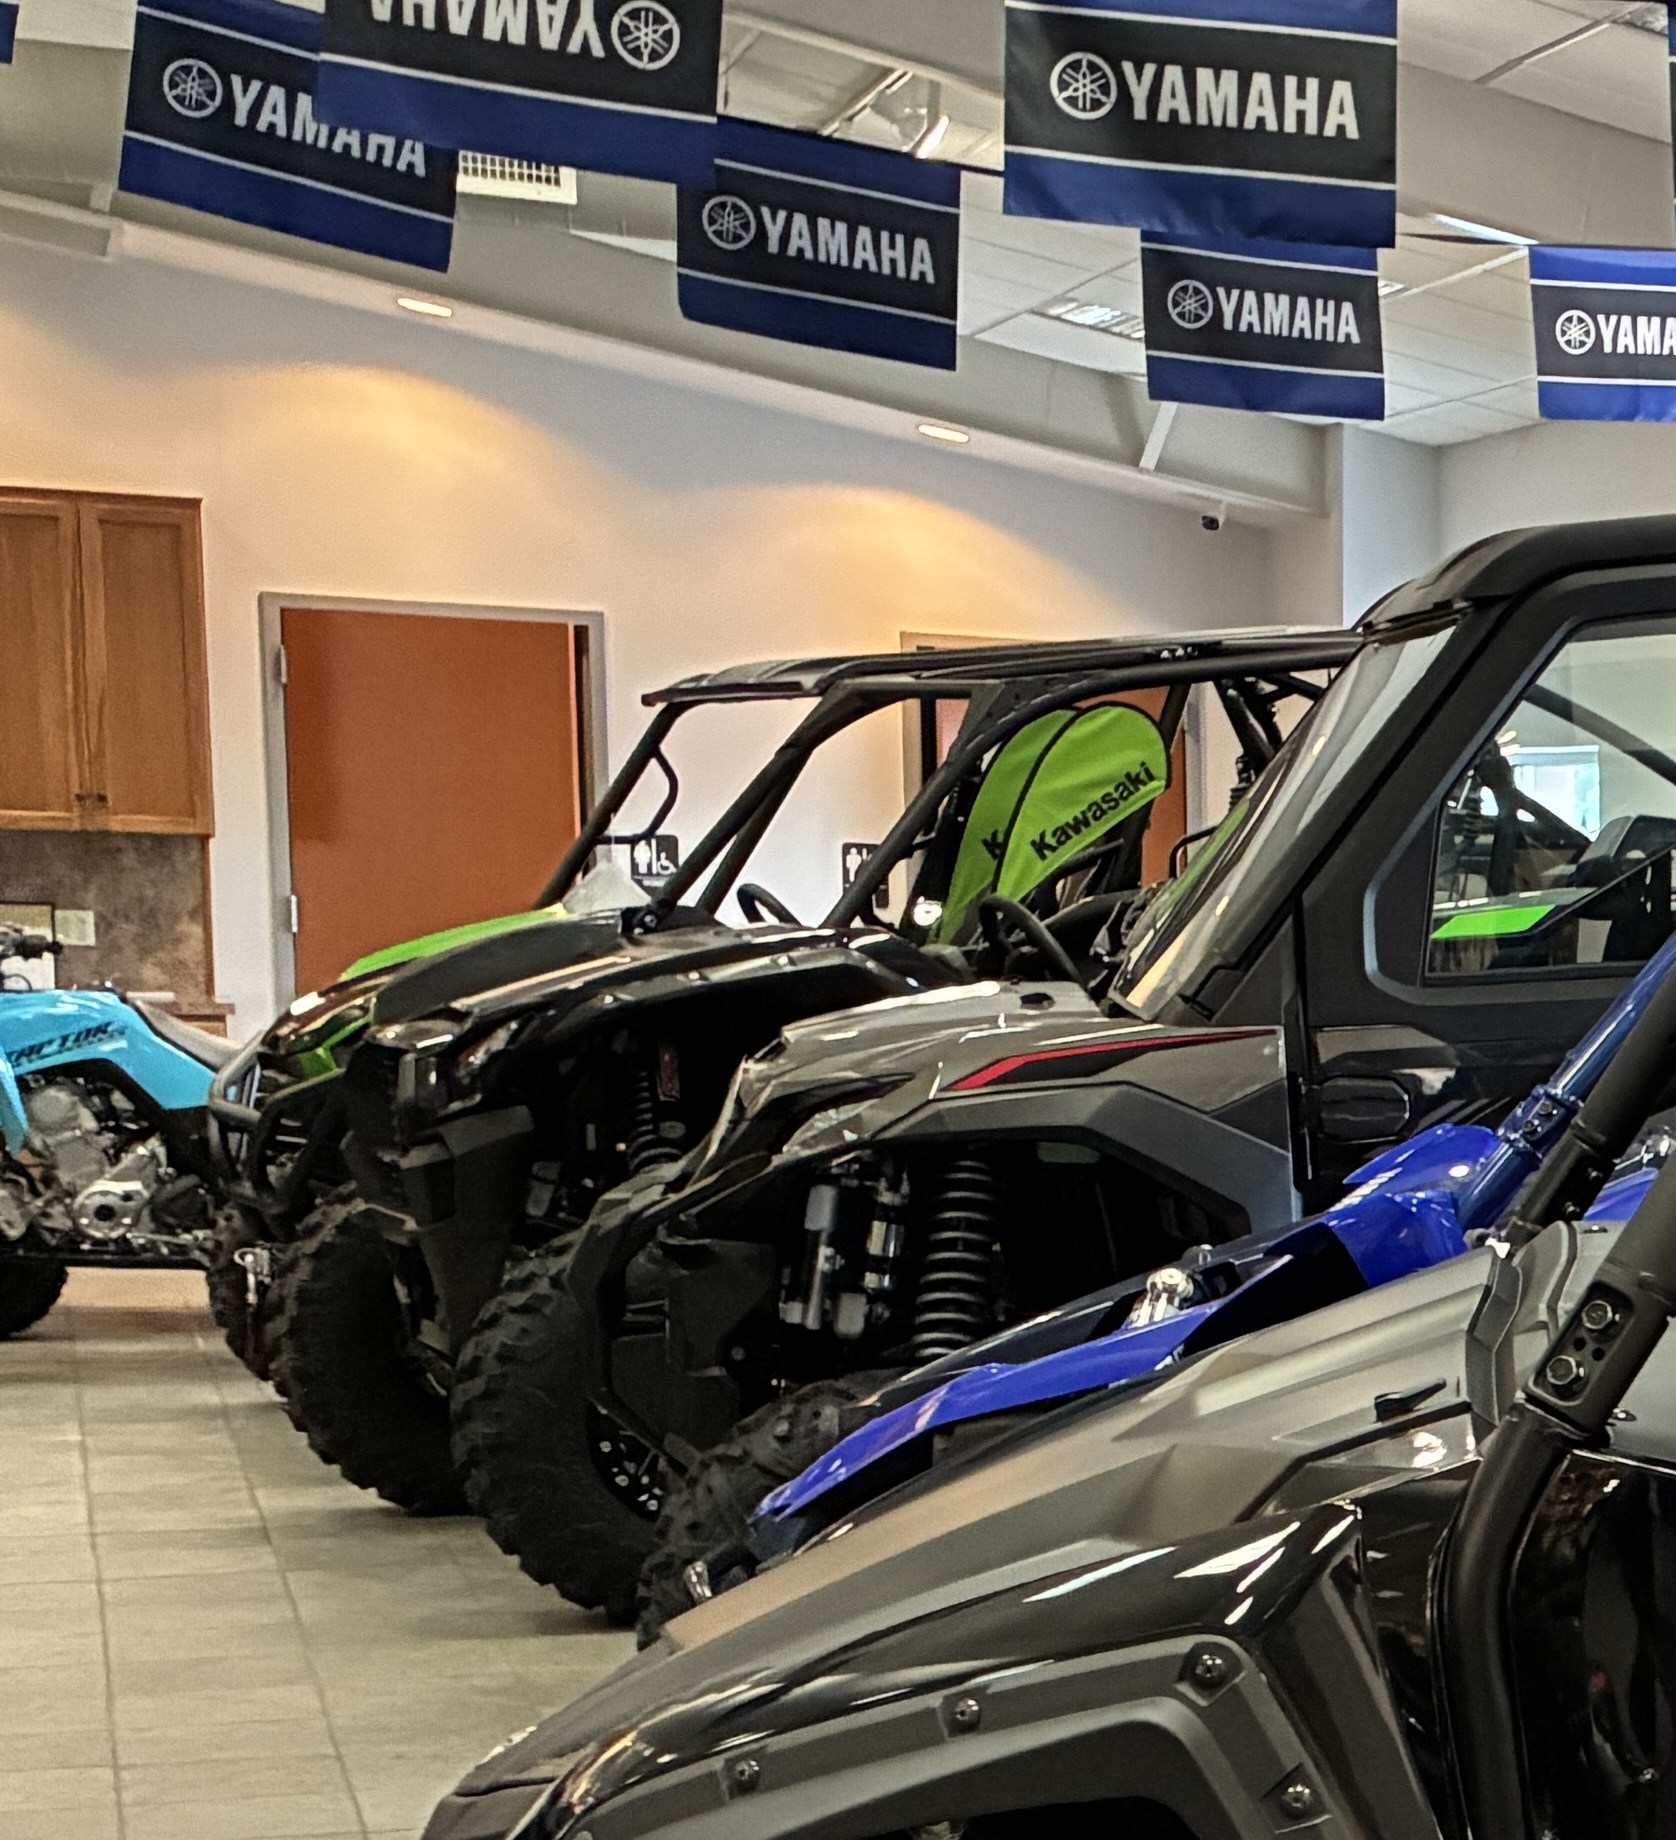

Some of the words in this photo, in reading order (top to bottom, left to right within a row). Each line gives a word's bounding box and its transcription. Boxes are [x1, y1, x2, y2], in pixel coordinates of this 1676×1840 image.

[1122, 61, 1359, 141] YAMAHA
[760, 206, 935, 284] YAMAHA
[1216, 286, 1361, 345] YAMAHA
[1029, 761, 1157, 862] Kawasaki
